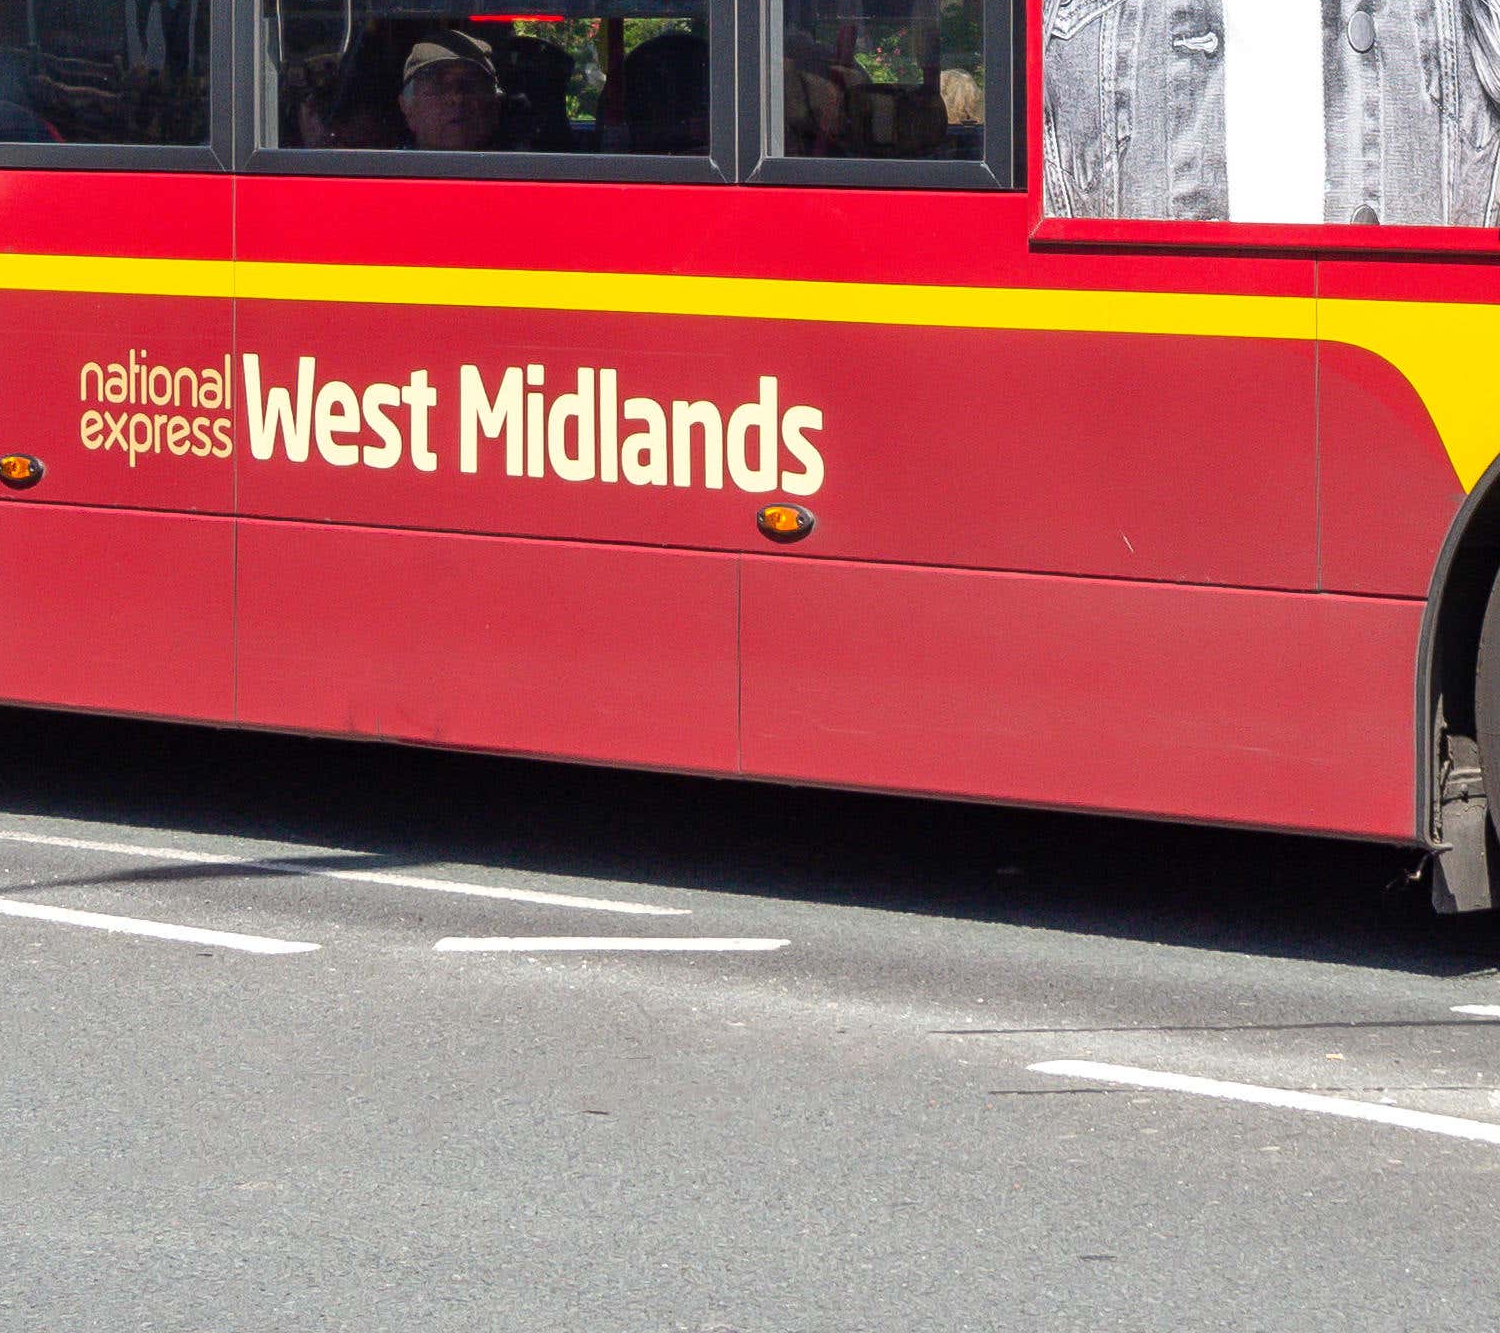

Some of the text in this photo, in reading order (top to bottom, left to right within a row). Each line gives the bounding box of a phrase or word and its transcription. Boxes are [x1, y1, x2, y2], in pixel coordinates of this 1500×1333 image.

[80, 348, 825, 497] national West Midlands
[80, 408, 233, 468] express
